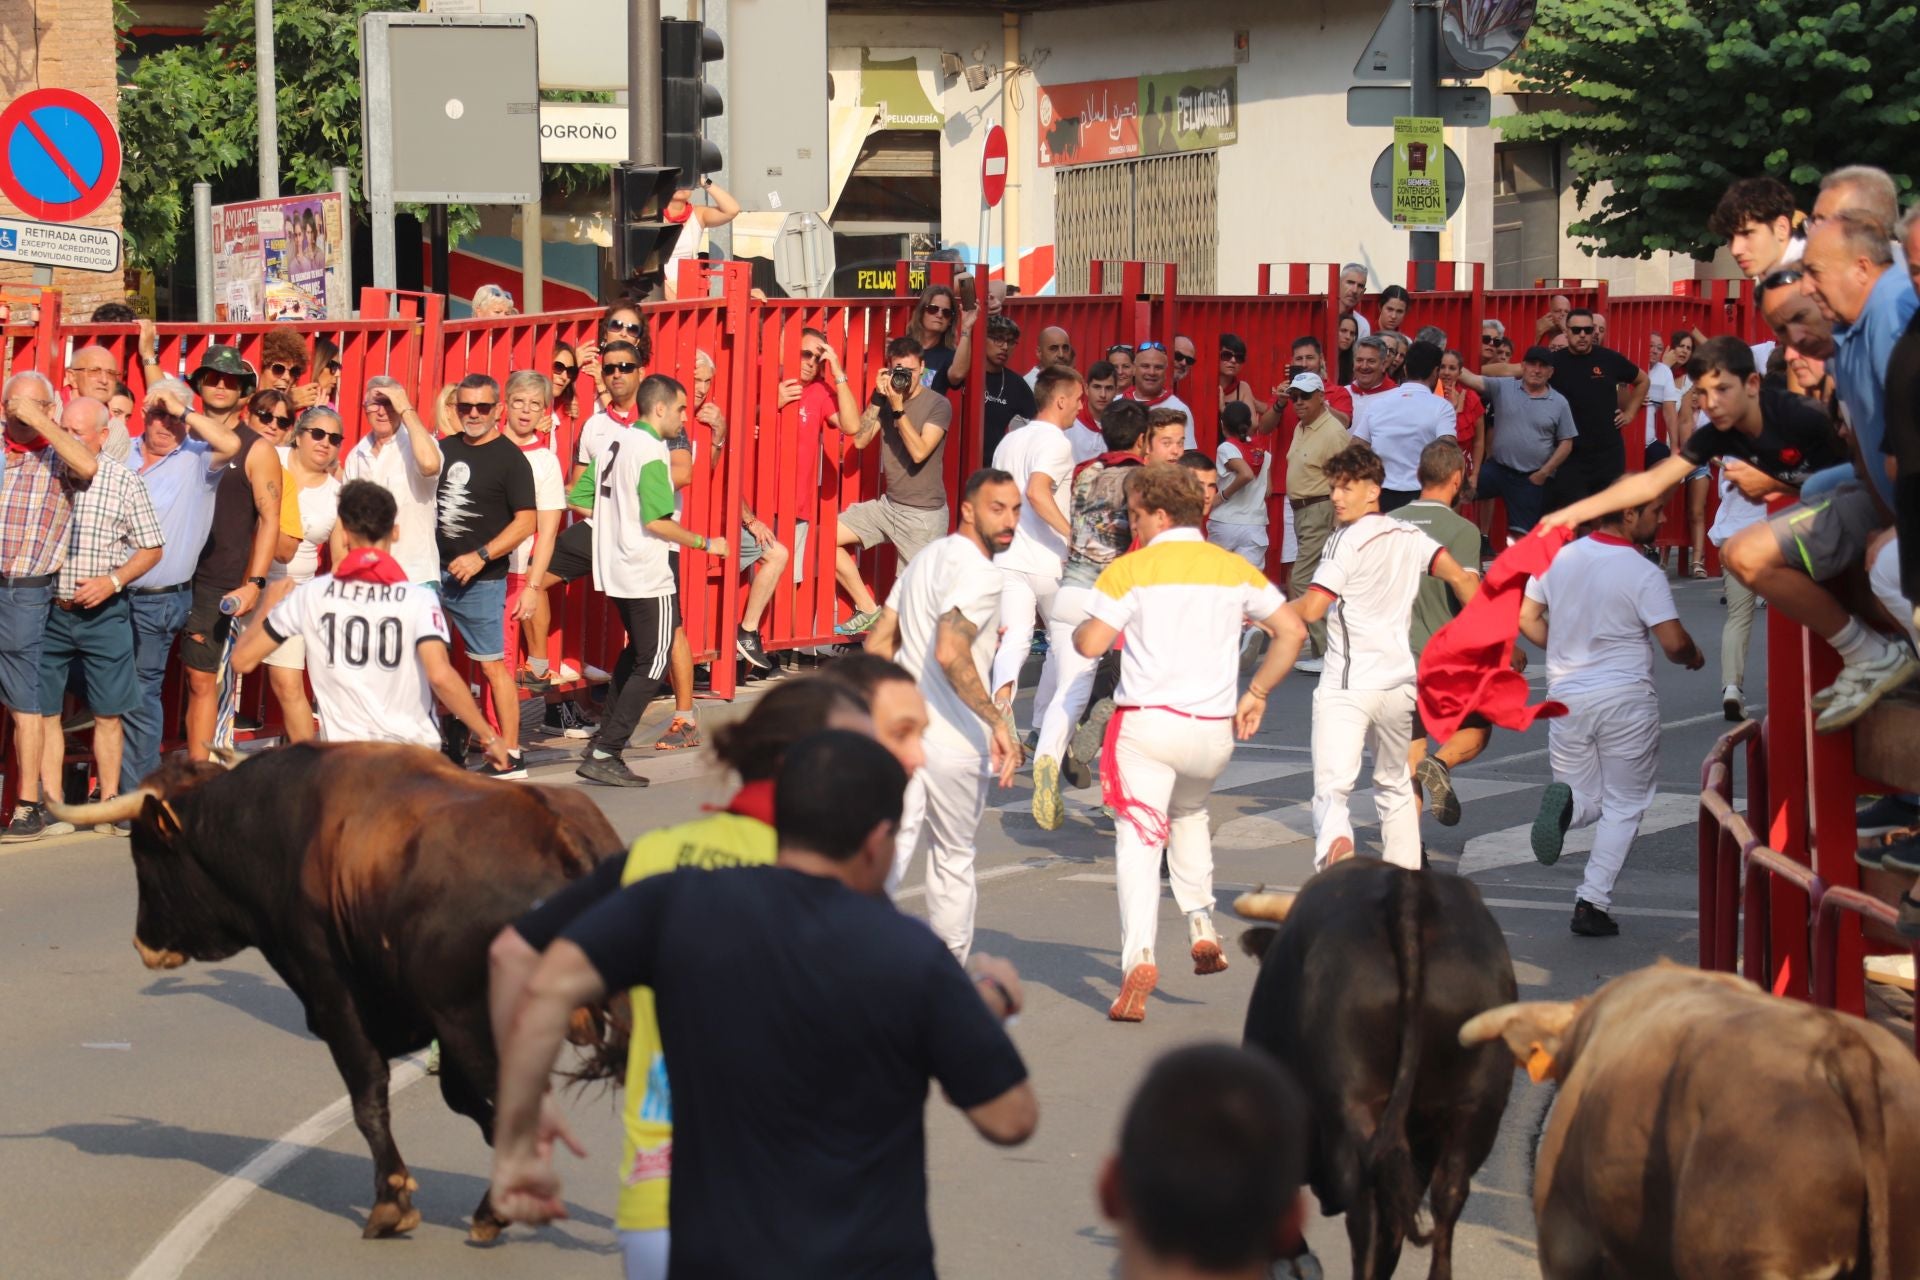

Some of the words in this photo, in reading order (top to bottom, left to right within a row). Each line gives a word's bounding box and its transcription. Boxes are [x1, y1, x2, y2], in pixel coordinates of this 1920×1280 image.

[887, 113, 939, 124] PELUQUERÍA
[540, 123, 617, 139] OGROÑO
[1420, 125, 1440, 134] COMIDA
[1408, 178, 1431, 186] SIEMPRE
[1397, 186, 1440, 195] CONTENEDOR
[1397, 194, 1440, 209] MARRÓN
[25, 227, 76, 242] RETIRADA
[21, 239, 56, 250] EXCEPTO
[58, 243, 111, 256] ACREDITADOS
[30, 250, 72, 261] MOVILIDAD
[73, 255, 113, 266] REDUCIDA
[323, 580, 407, 603] ALFARO
[318, 611, 403, 669] 100
